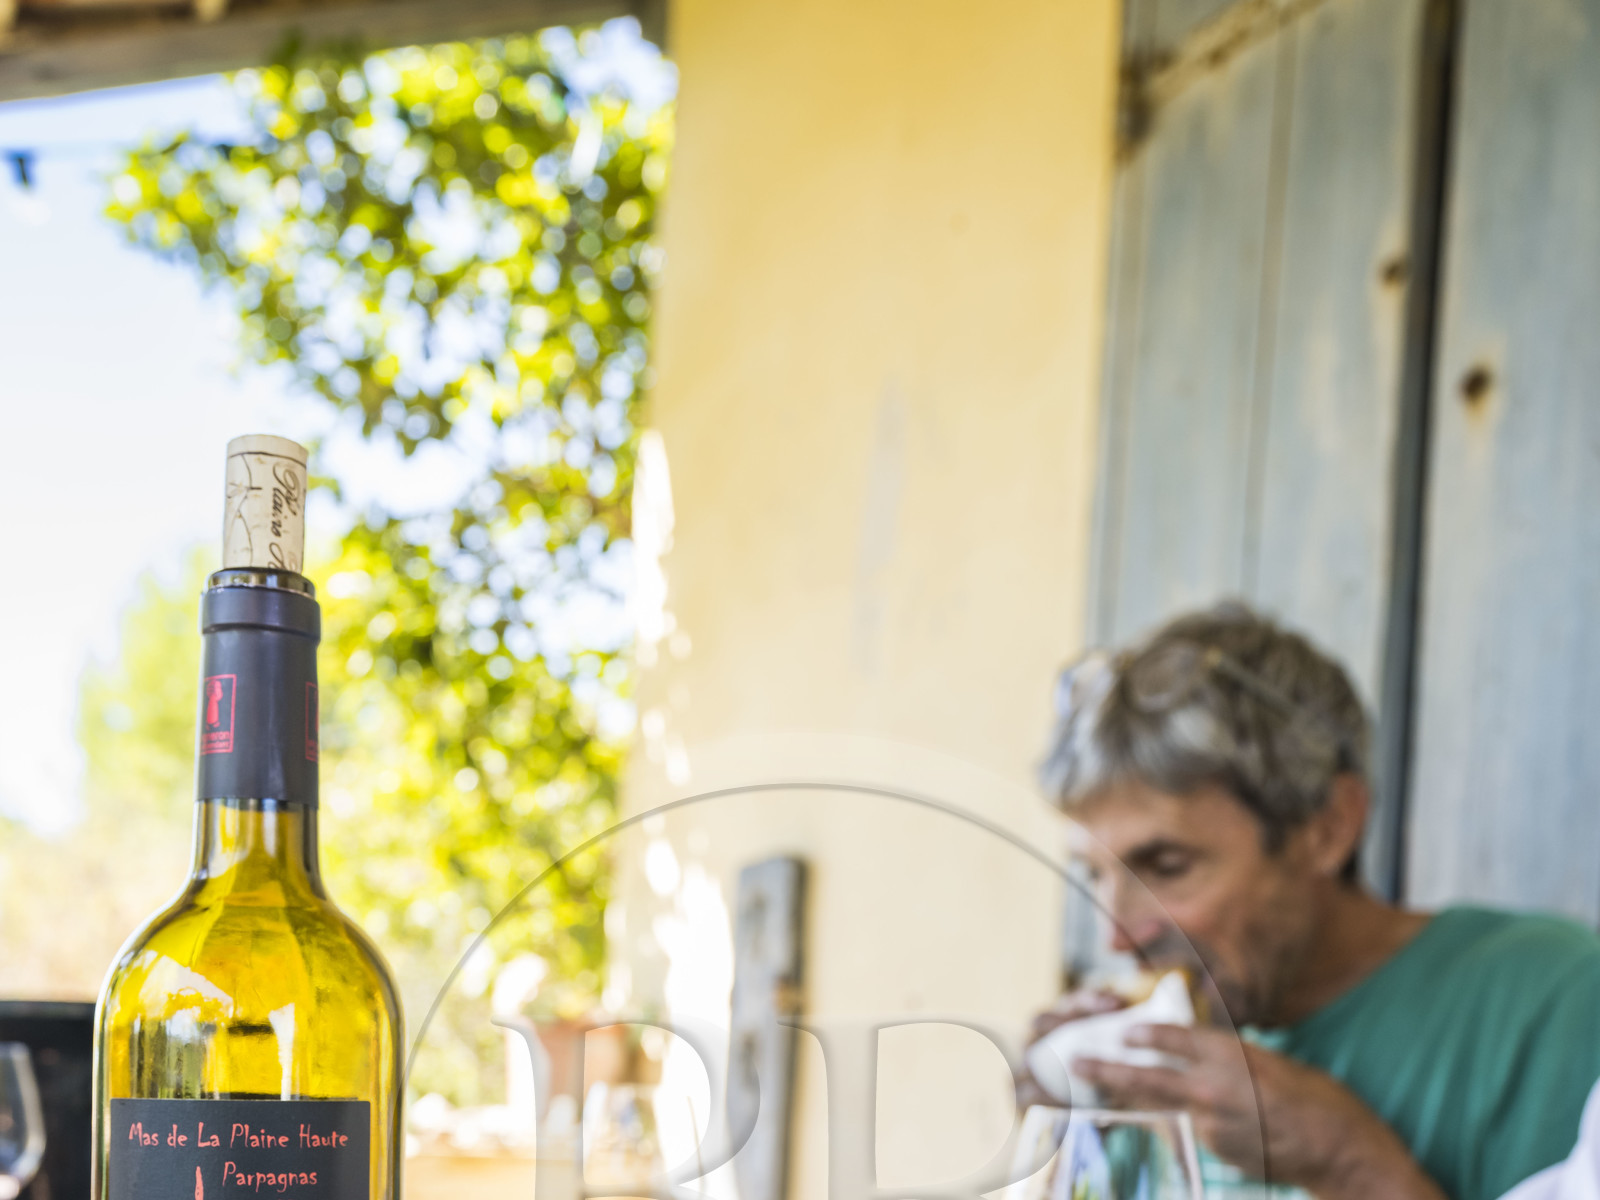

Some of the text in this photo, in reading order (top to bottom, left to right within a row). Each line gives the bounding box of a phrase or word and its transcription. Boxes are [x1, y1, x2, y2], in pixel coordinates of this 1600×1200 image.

[128, 1121, 349, 1149] Mas de La Plaine Haute
[222, 1160, 318, 1193] Parpagnas
